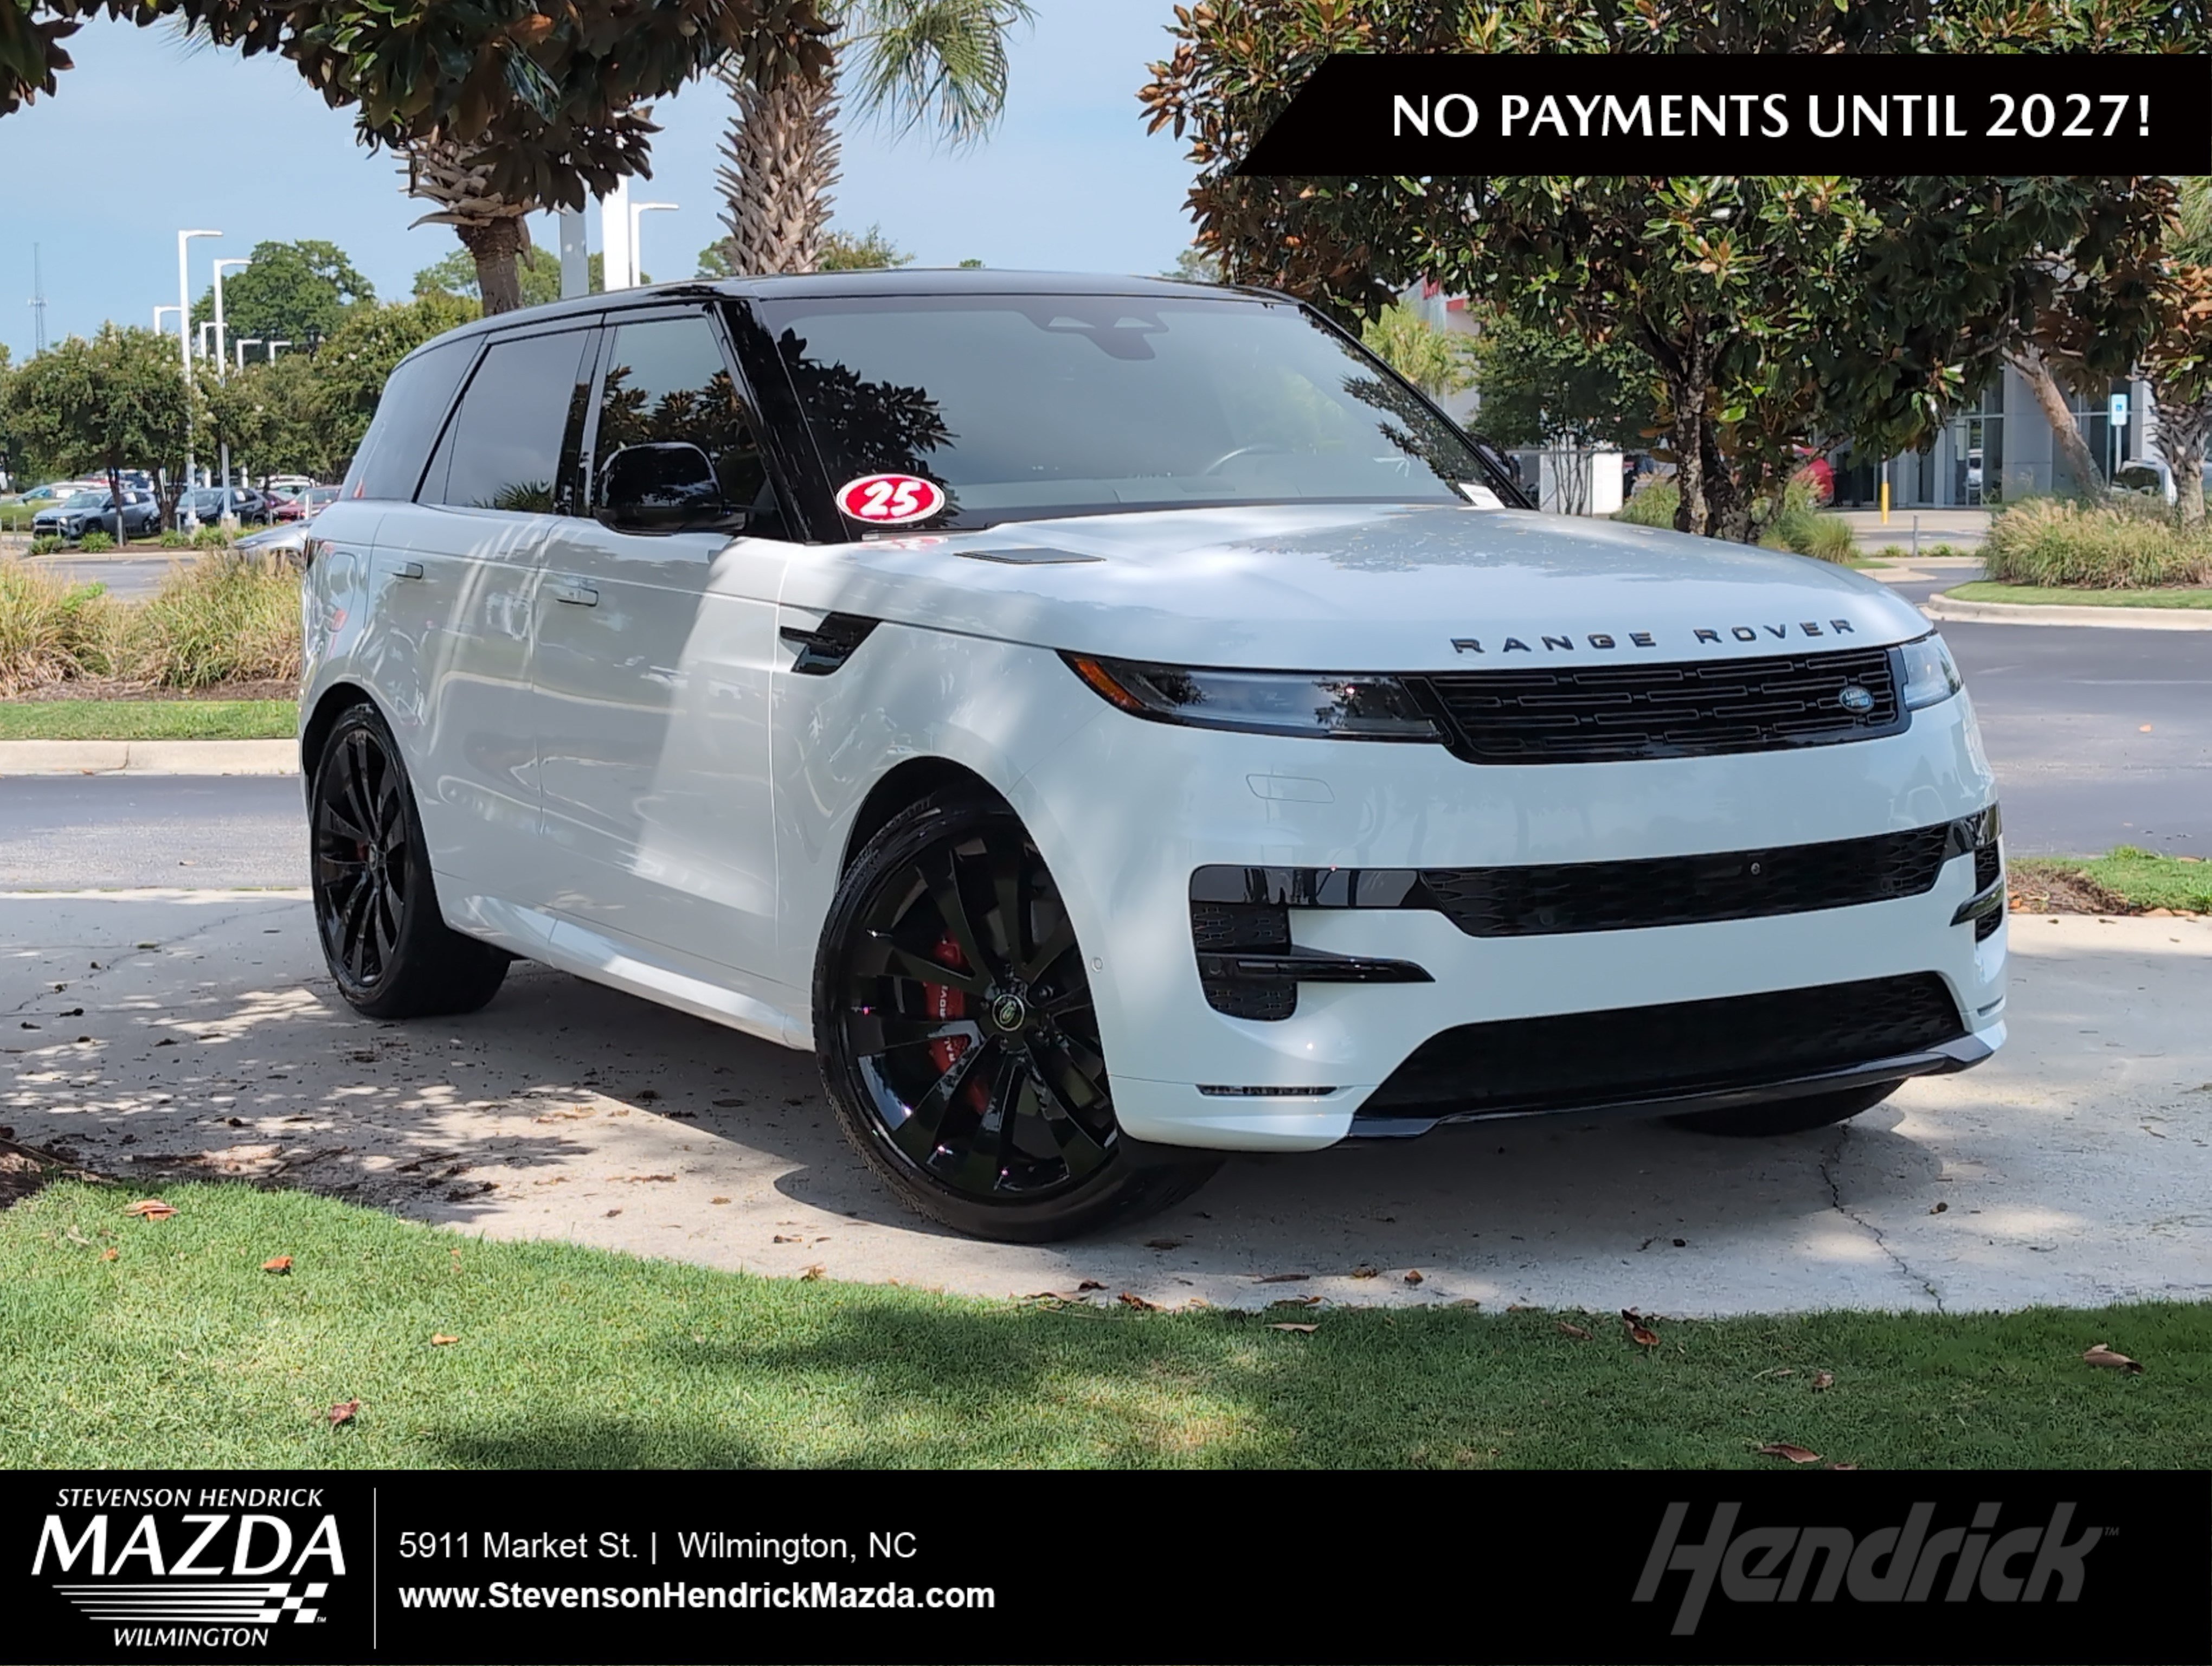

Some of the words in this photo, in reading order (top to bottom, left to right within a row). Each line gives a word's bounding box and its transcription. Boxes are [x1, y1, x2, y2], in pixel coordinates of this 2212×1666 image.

[859, 480, 922, 516] 25
[1450, 632, 1657, 653] RANGE
[1693, 619, 1855, 644] ROVER
